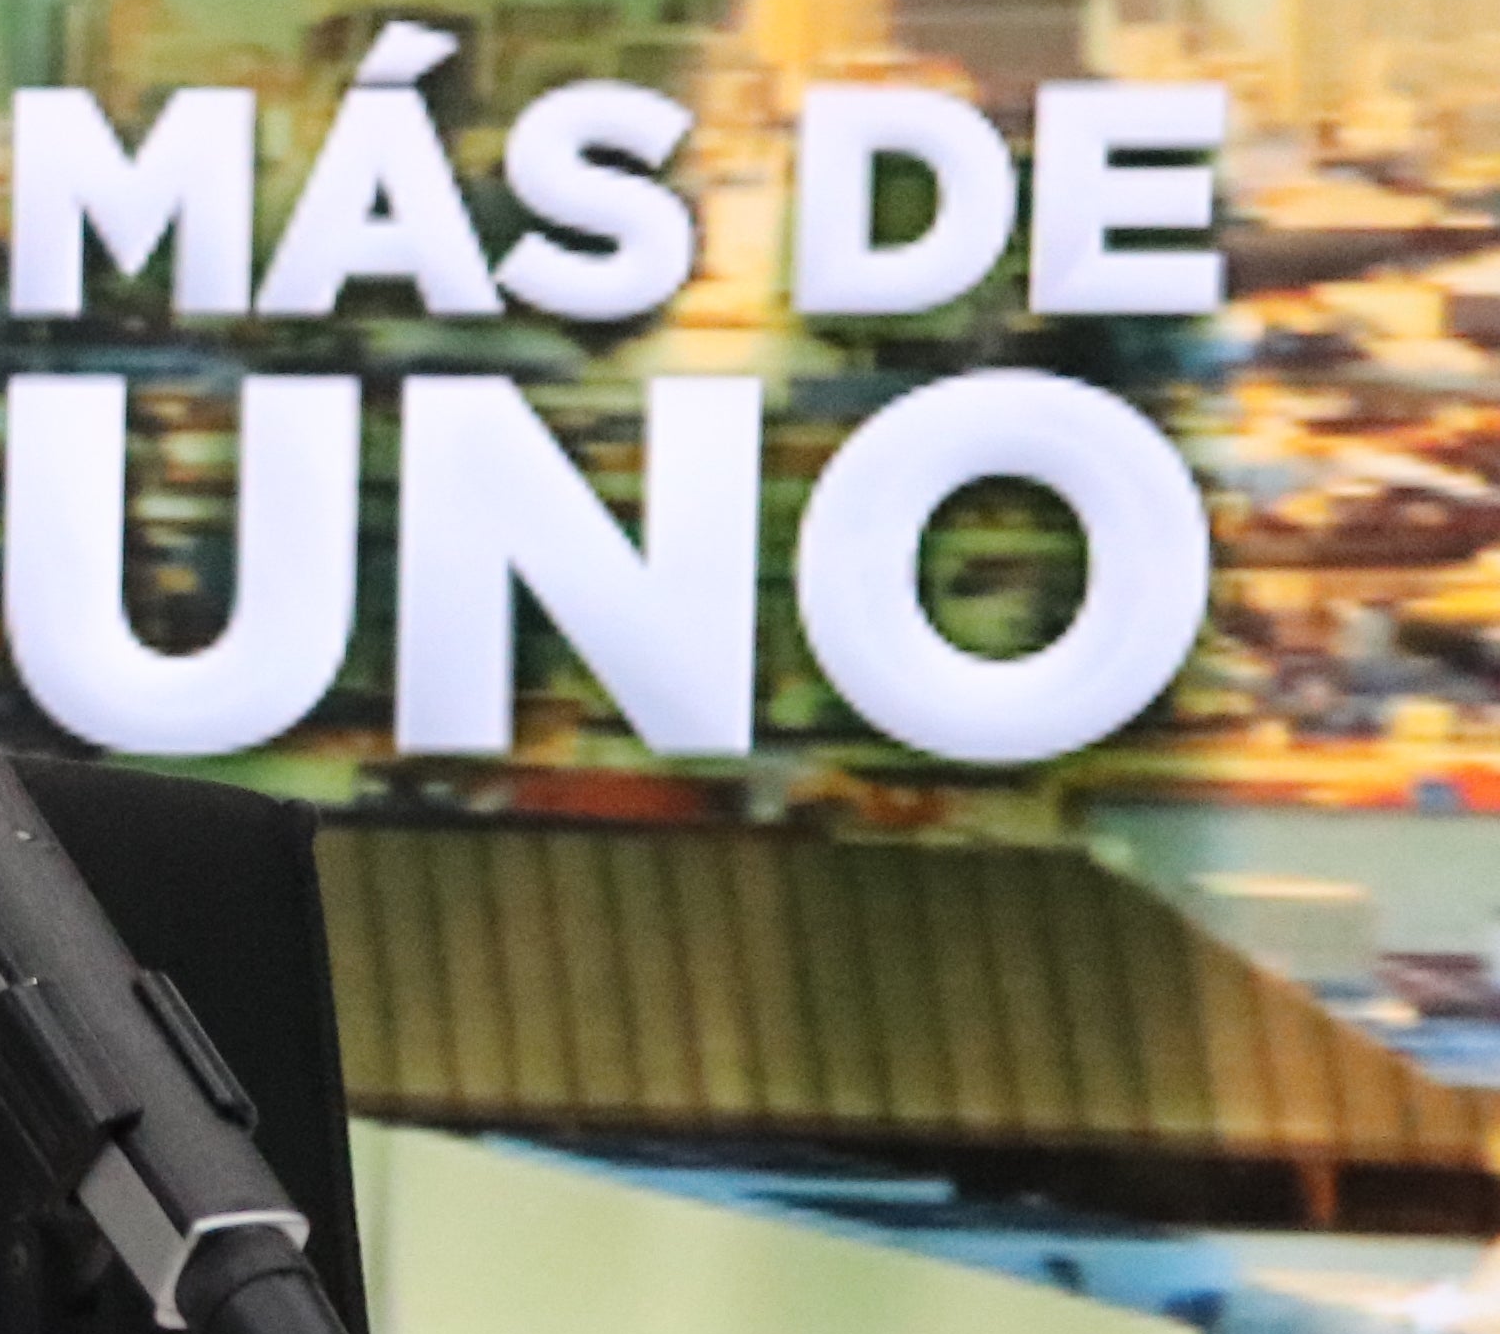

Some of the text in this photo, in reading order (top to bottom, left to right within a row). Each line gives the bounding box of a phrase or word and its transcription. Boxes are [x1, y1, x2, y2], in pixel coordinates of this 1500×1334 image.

[8, 20, 1227, 322] MÁS DE
[4, 365, 1210, 764] UNO
